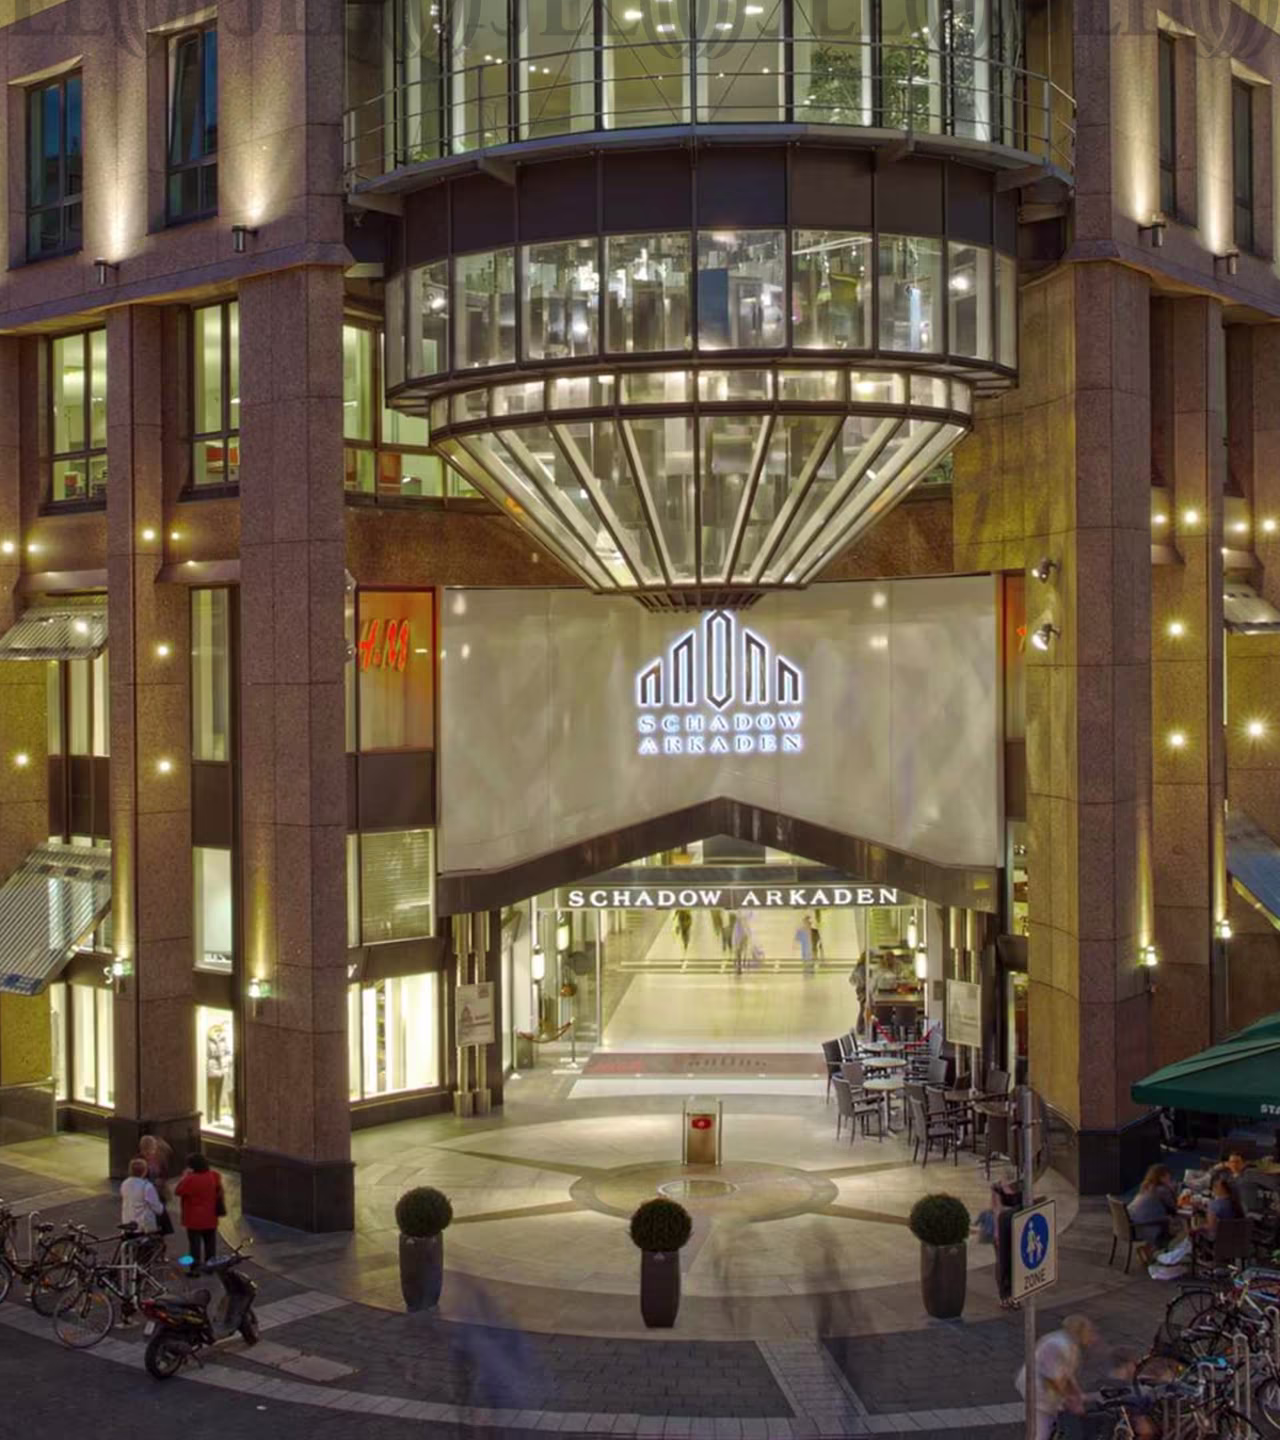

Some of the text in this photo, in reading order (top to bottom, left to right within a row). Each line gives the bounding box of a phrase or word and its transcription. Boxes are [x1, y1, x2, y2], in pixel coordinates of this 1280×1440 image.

[638, 713, 801, 733] SCHADOW
[638, 734, 802, 754] ARKADEN
[568, 887, 899, 908] SCHADOW ARKADEN
[1024, 1268, 1046, 1290] ZONE
